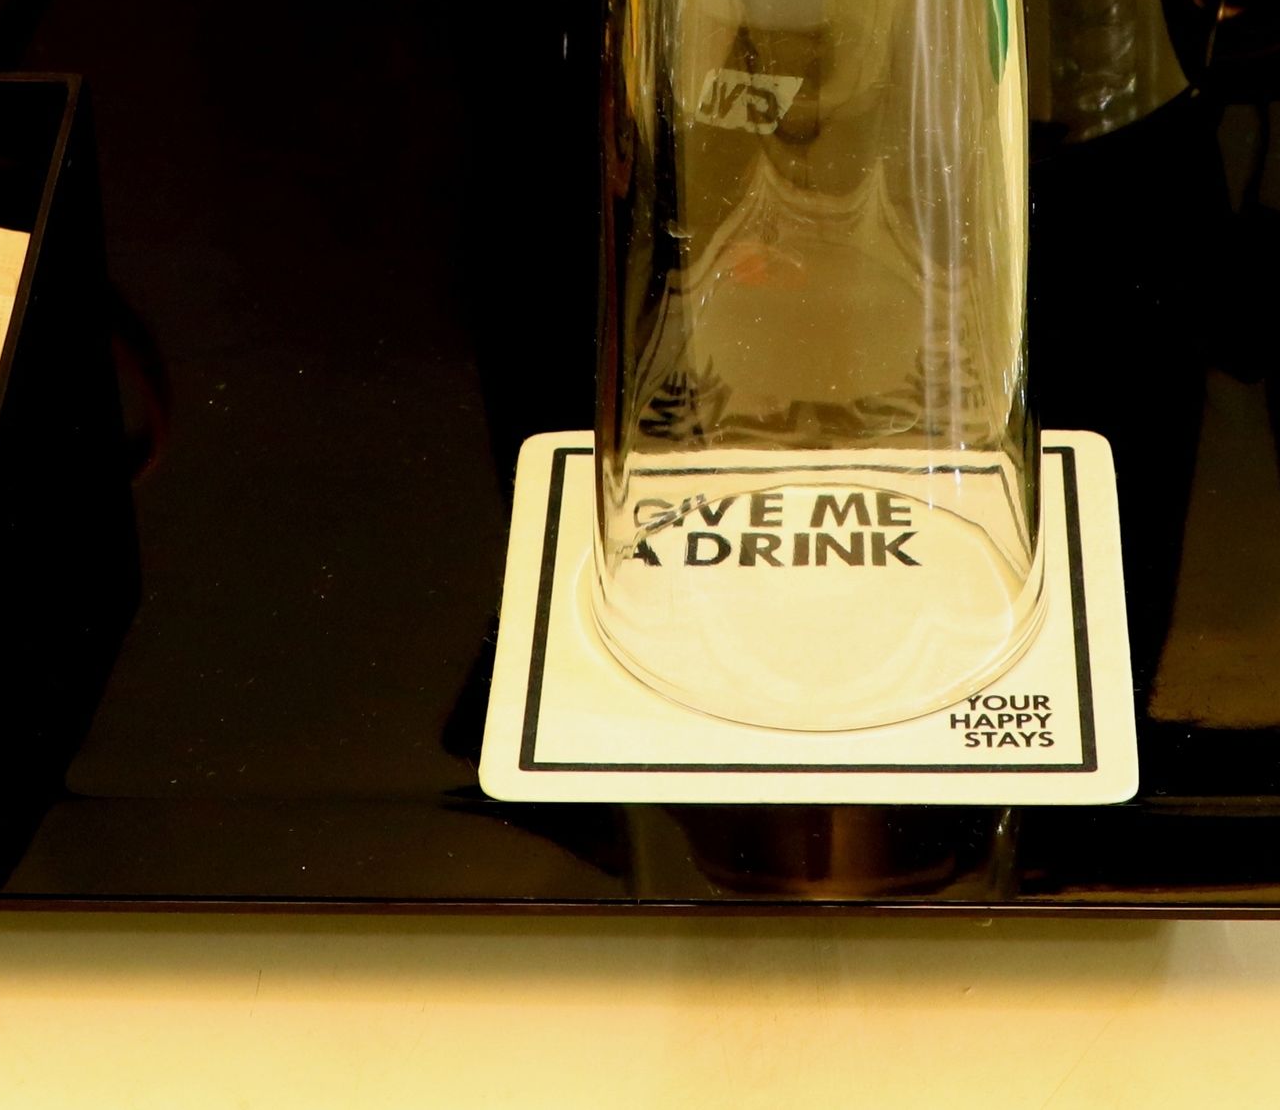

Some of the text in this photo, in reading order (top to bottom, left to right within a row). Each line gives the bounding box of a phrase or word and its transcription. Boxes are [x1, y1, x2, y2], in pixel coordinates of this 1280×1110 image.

[633, 492, 914, 530] GIVE ME
[683, 531, 923, 567] DRINK
[968, 694, 1051, 712] YOUR
[950, 712, 1053, 730] HAPPY
[964, 730, 1055, 748] STAYS
